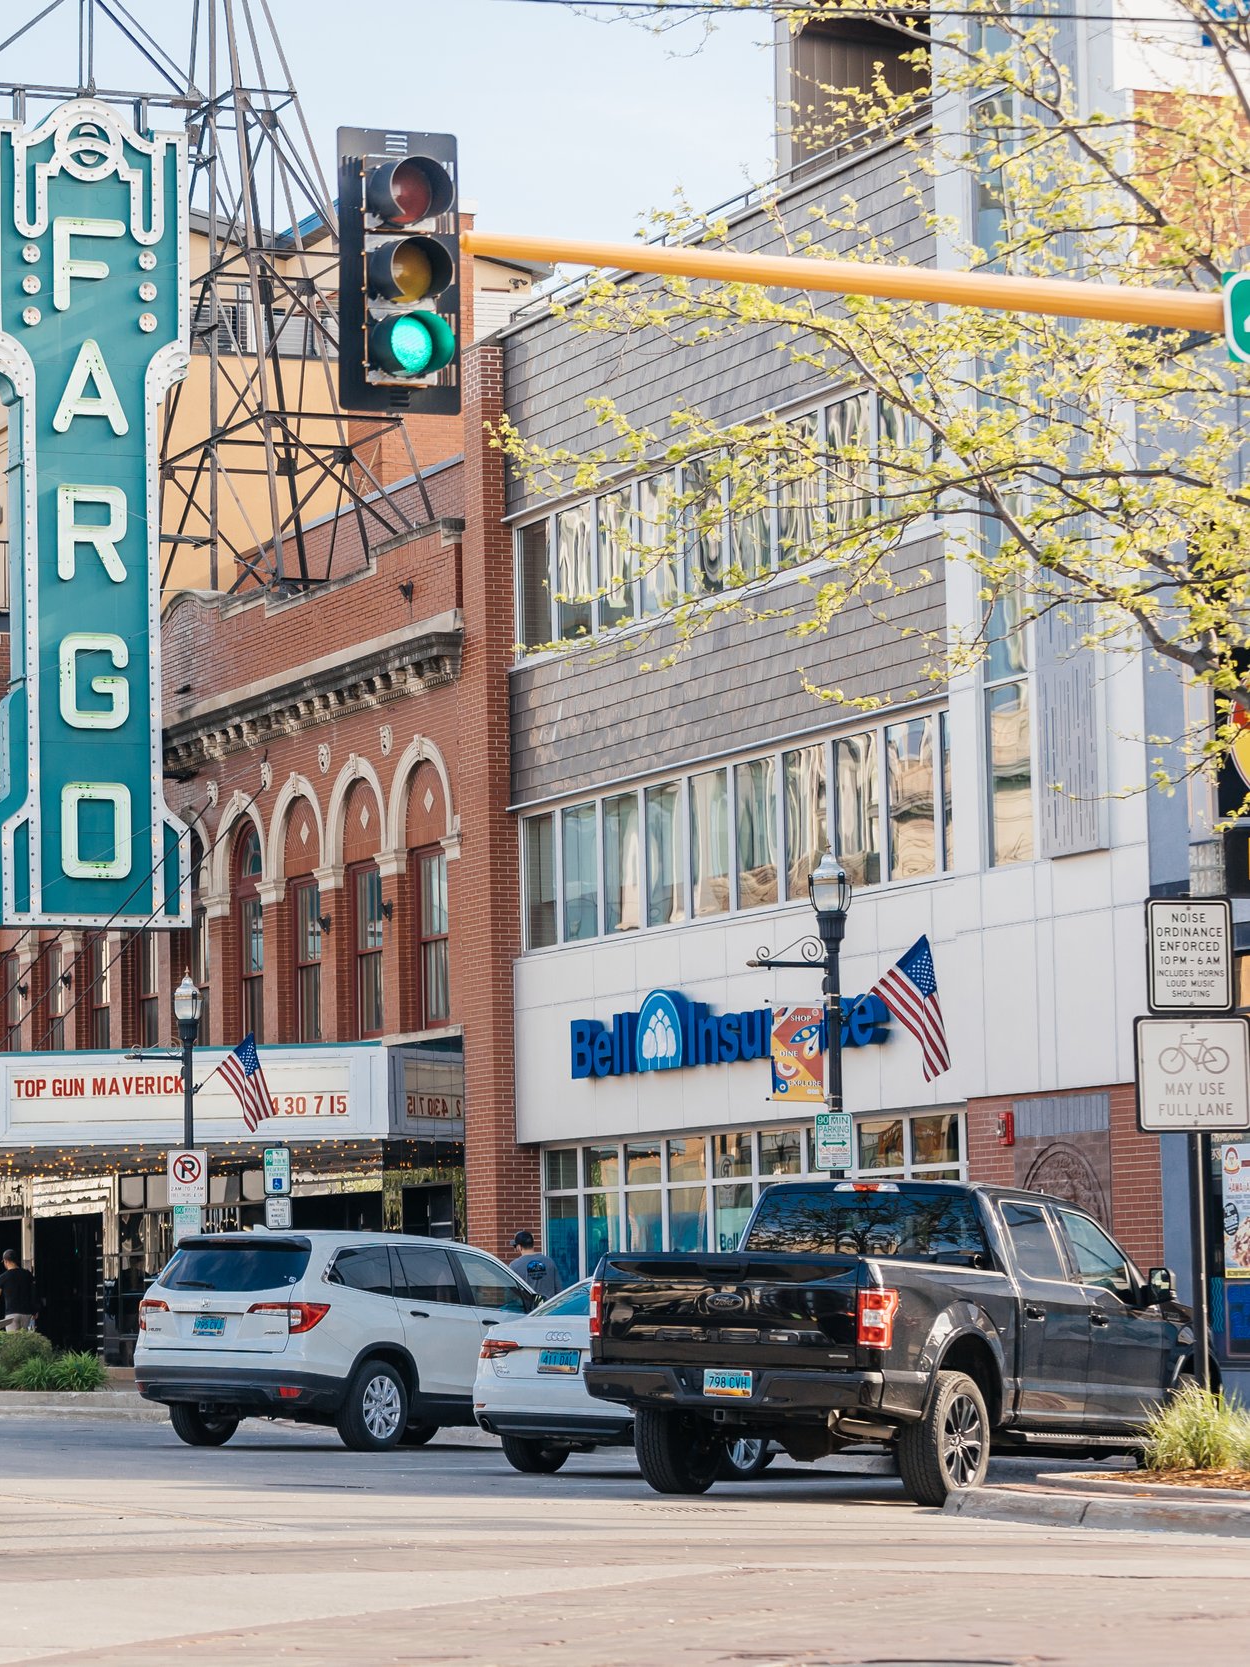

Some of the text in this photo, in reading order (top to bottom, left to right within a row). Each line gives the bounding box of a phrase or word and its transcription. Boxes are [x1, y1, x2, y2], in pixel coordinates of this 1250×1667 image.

[52, 216, 133, 881] FARGO
[1171, 913, 1206, 923] NOISE
[1156, 927, 1223, 937] ORDINANCE
[1160, 941, 1220, 951] ENFORCED
[1156, 969, 1194, 977] INCLUDES
[1172, 990, 1211, 998] SHOUTING
[790, 1014, 812, 1022] SHOP
[571, 1011, 635, 1079] Bell
[14, 1075, 184, 1098] TOP GUN MAVERICK
[1165, 1082, 1225, 1095] MAY USE
[313, 1095, 323, 1114] 7
[329, 1095, 347, 1114] 15
[1158, 1103, 1234, 1116] FULL LANE
[817, 1115, 849, 1125] 90 MIN
[818, 1126, 850, 1134] PARKING
[719, 1232, 739, 1251] Bell
[543, 1355, 557, 1366] 411
[709, 1376, 747, 1389] 798 CVH
